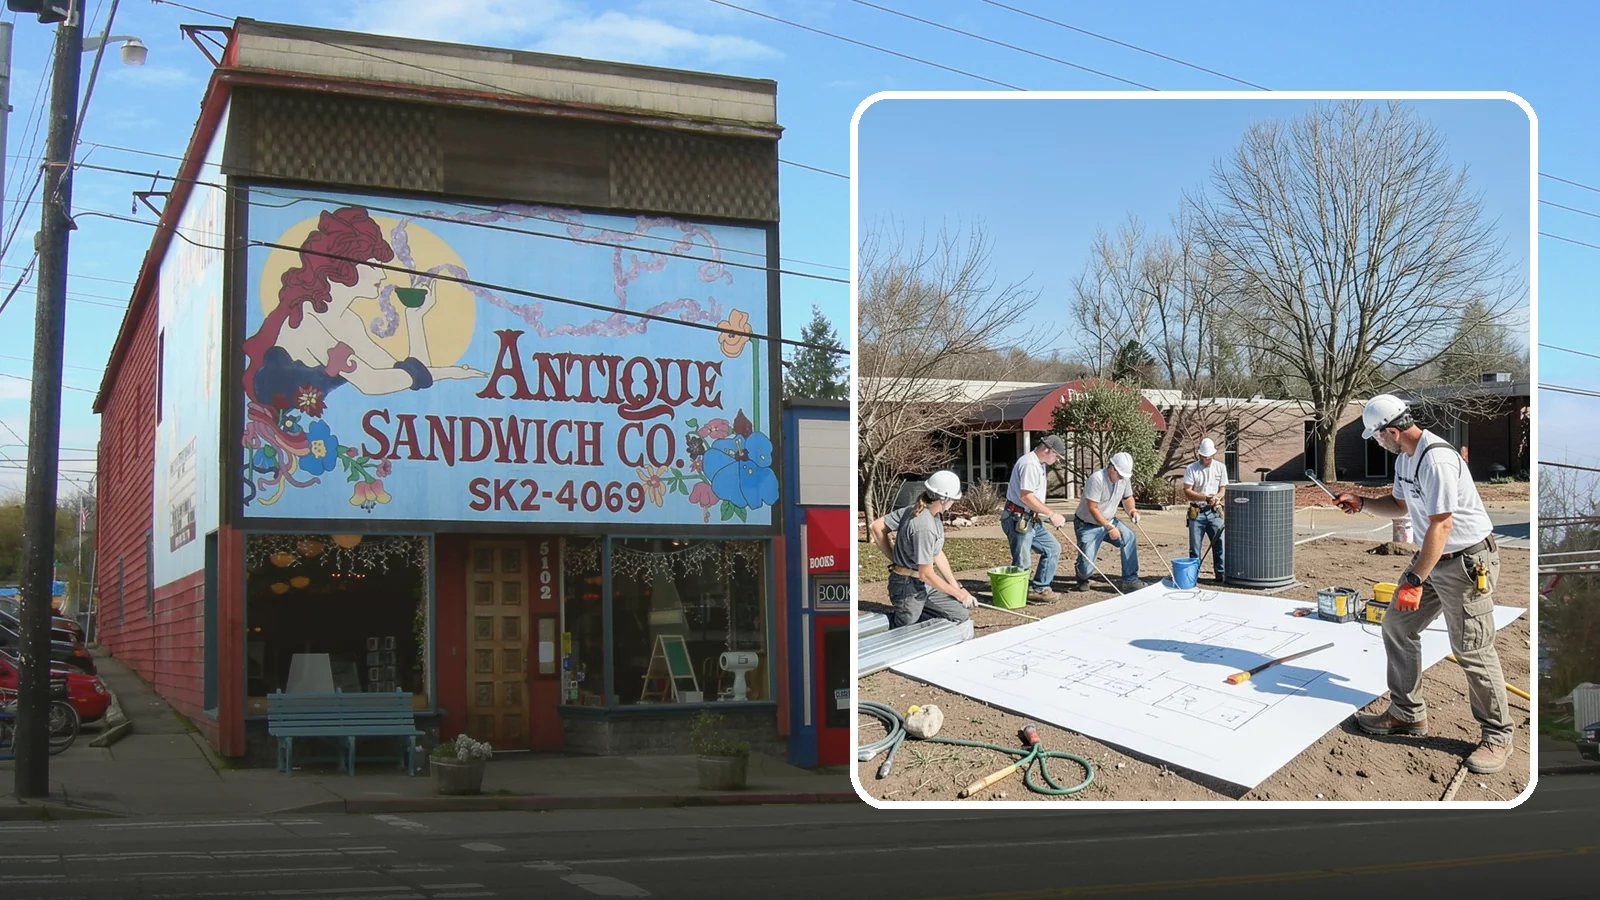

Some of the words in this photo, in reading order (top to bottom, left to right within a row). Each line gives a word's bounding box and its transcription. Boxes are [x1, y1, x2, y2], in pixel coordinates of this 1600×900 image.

[475, 328, 724, 421] ANTIQUE
[361, 408, 605, 467] SANDWICH
[617, 421, 685, 469] CO.
[468, 476, 646, 514] SK2-4069
[540, 541, 552, 600] 5102
[809, 554, 835, 569] BOOKS
